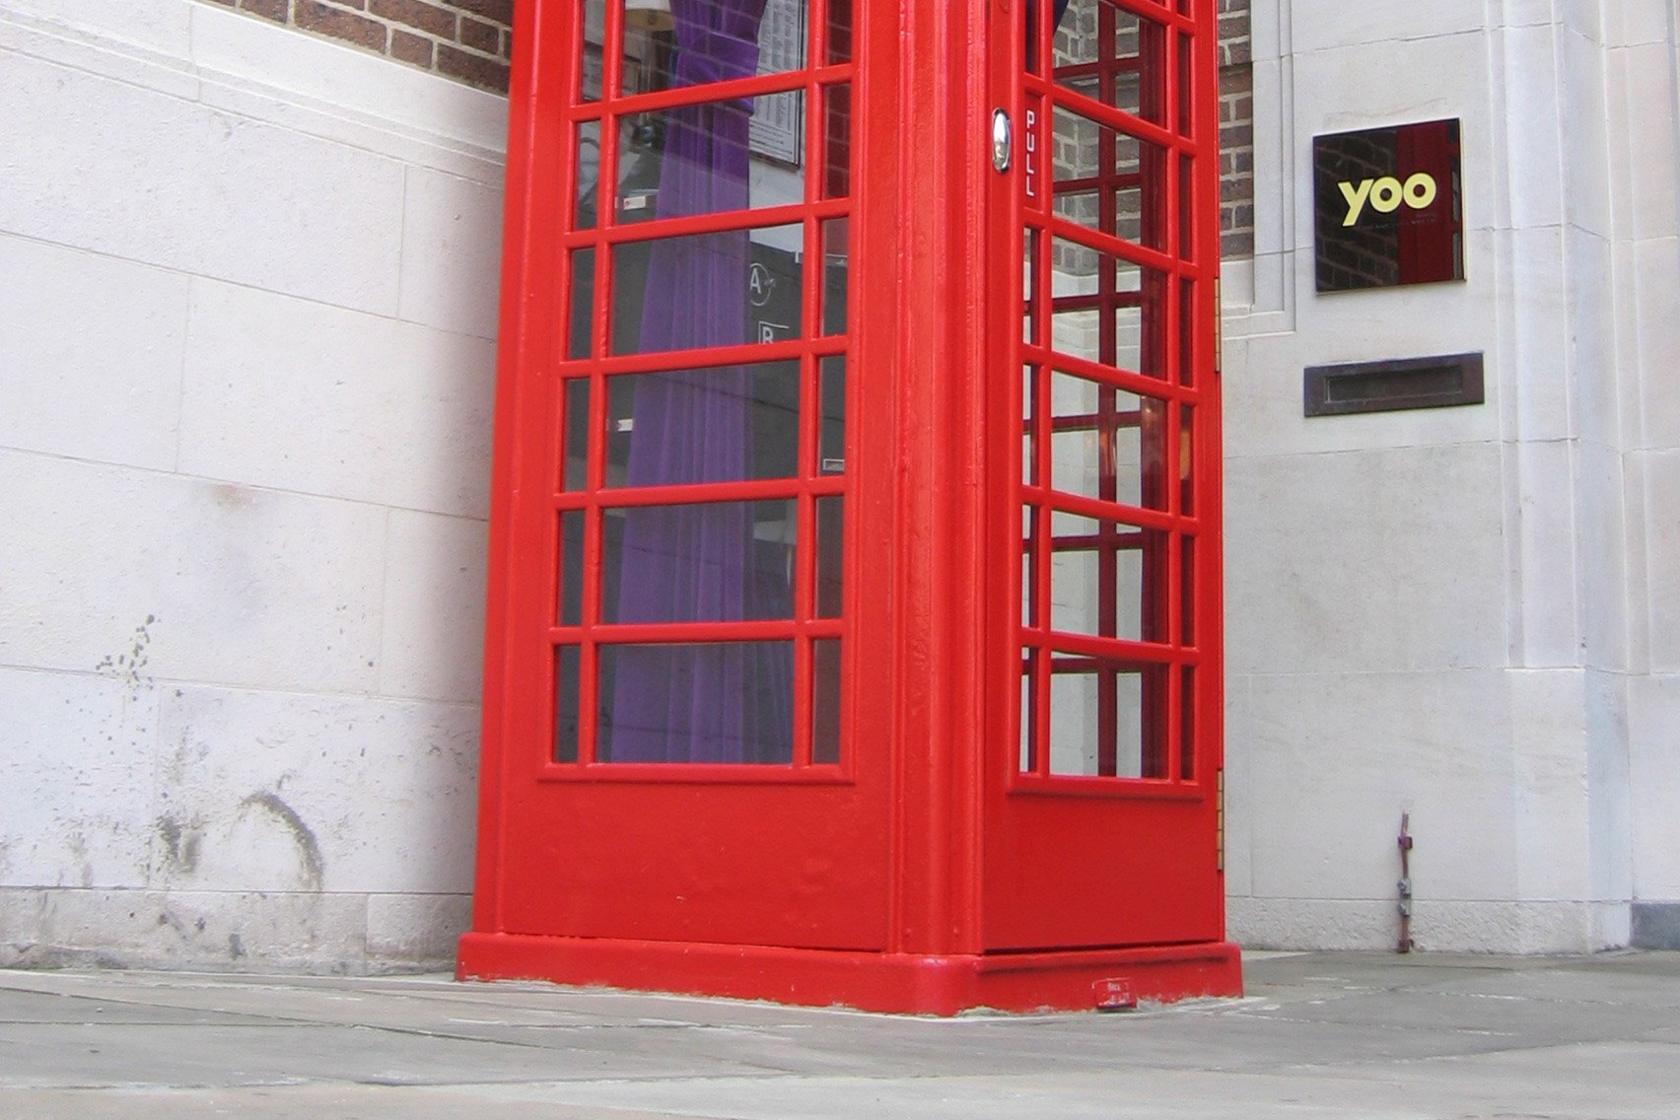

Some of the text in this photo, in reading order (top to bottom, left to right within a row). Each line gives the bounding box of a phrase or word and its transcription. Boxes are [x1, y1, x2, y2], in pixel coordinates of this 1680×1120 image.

[1026, 109, 1035, 196] PULL
[1338, 172, 1436, 227] yoo
[750, 268, 761, 294] A
